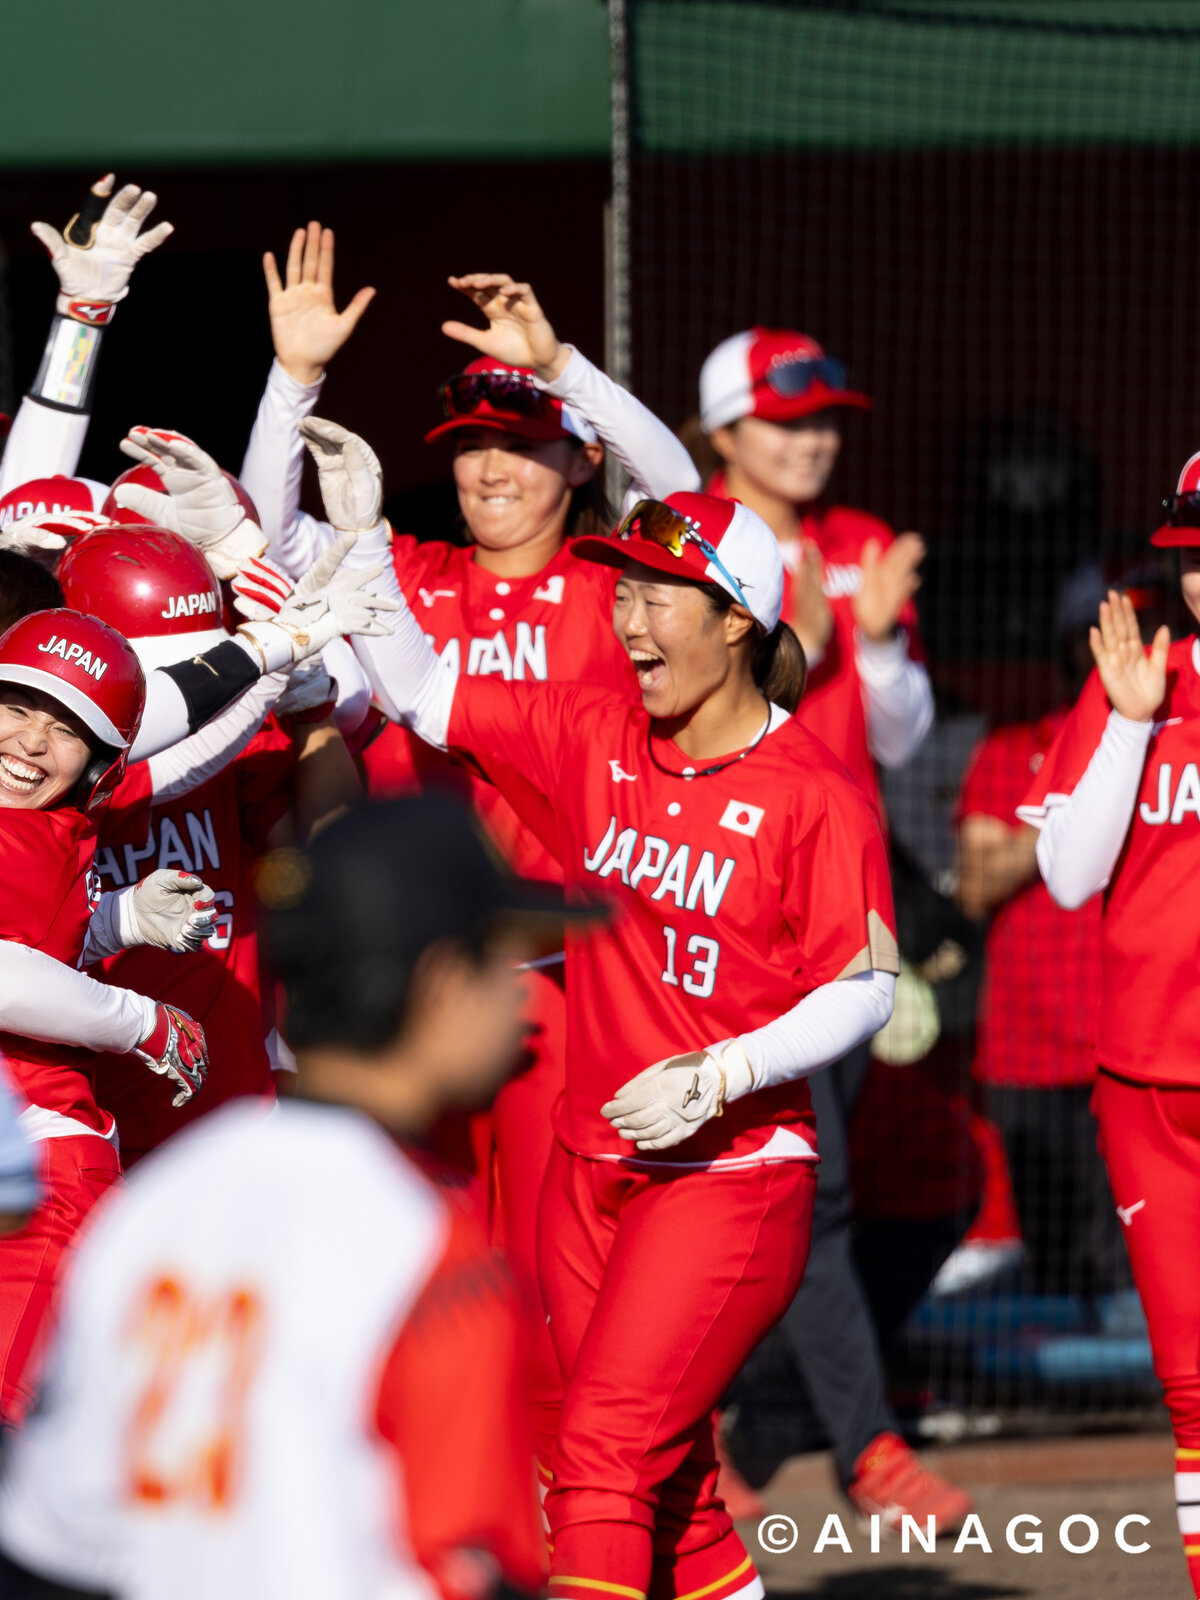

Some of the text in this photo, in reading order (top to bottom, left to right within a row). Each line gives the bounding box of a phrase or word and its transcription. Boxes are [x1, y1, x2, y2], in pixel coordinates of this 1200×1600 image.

[161, 590, 217, 619] JAPAN
[37, 634, 109, 681] JAPAN
[424, 621, 548, 681] APAN
[94, 808, 221, 886] APAN
[583, 815, 736, 918] JAPAN
[661, 925, 720, 999] 13
